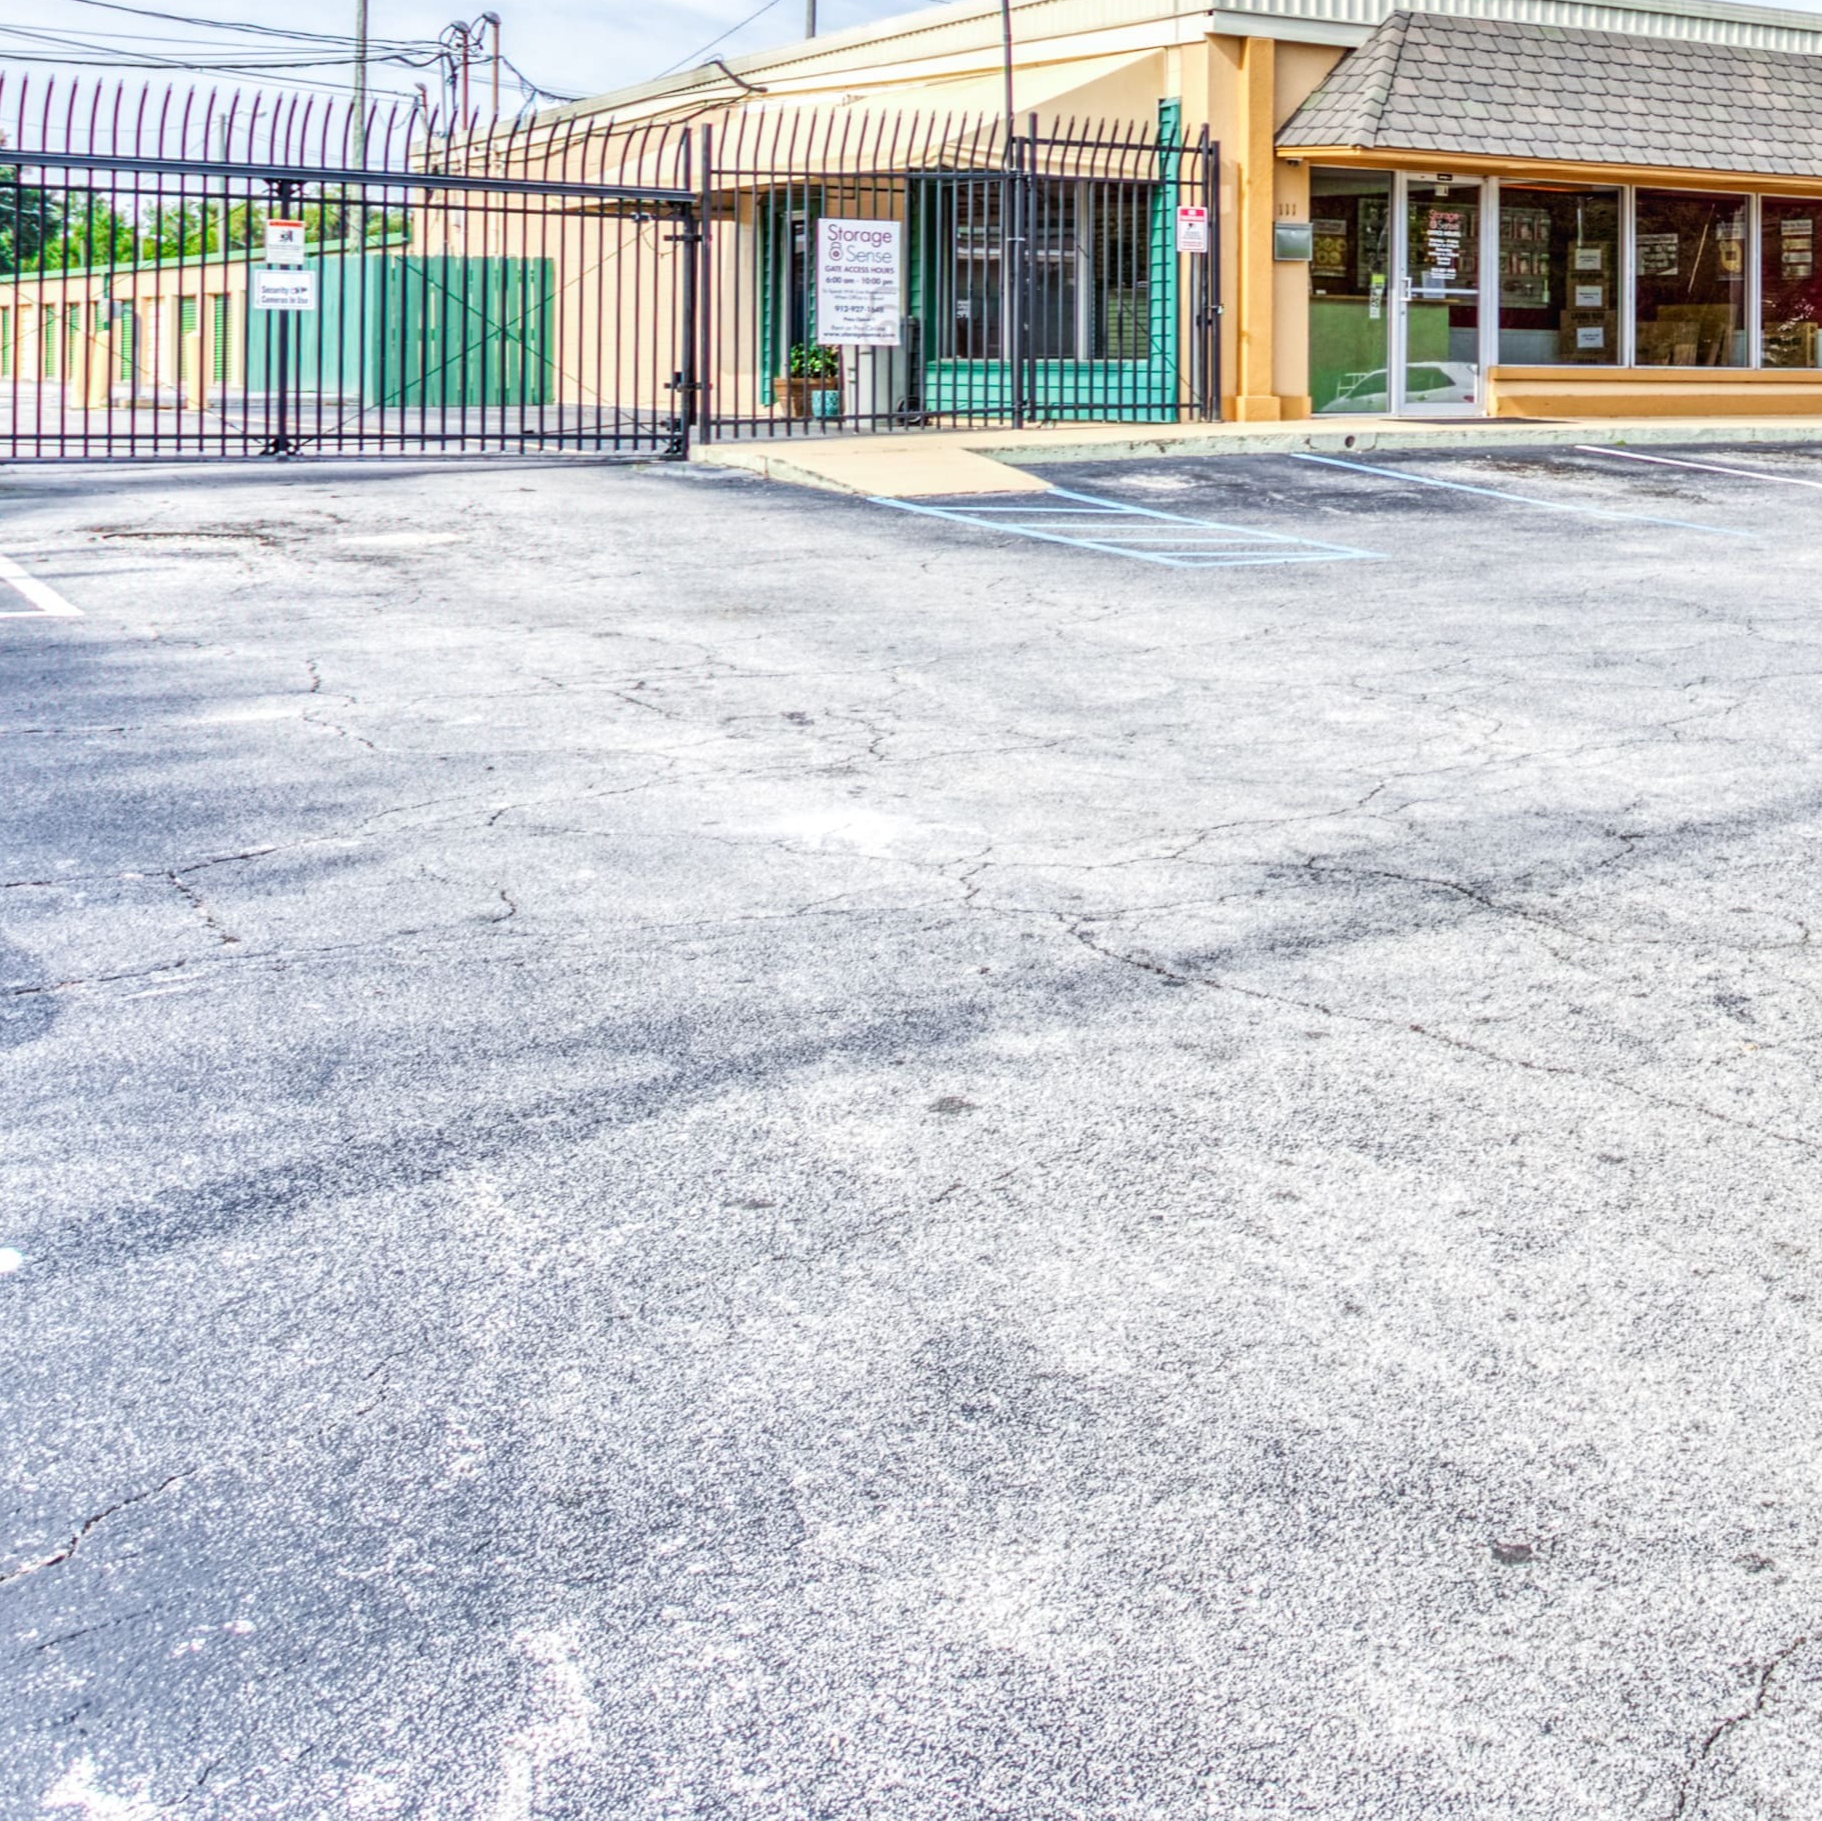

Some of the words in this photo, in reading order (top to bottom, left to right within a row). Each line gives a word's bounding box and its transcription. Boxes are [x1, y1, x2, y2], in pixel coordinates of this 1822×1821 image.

[827, 224, 892, 248] Storage
[845, 244, 892, 263] Sense
[824, 265, 842, 273] GATE
[844, 266, 869, 274] ACCESS
[871, 267, 895, 275] HOURS
[825, 276, 842, 284] 6:00
[861, 277, 881, 285] 10:00
[882, 279, 894, 287] pm
